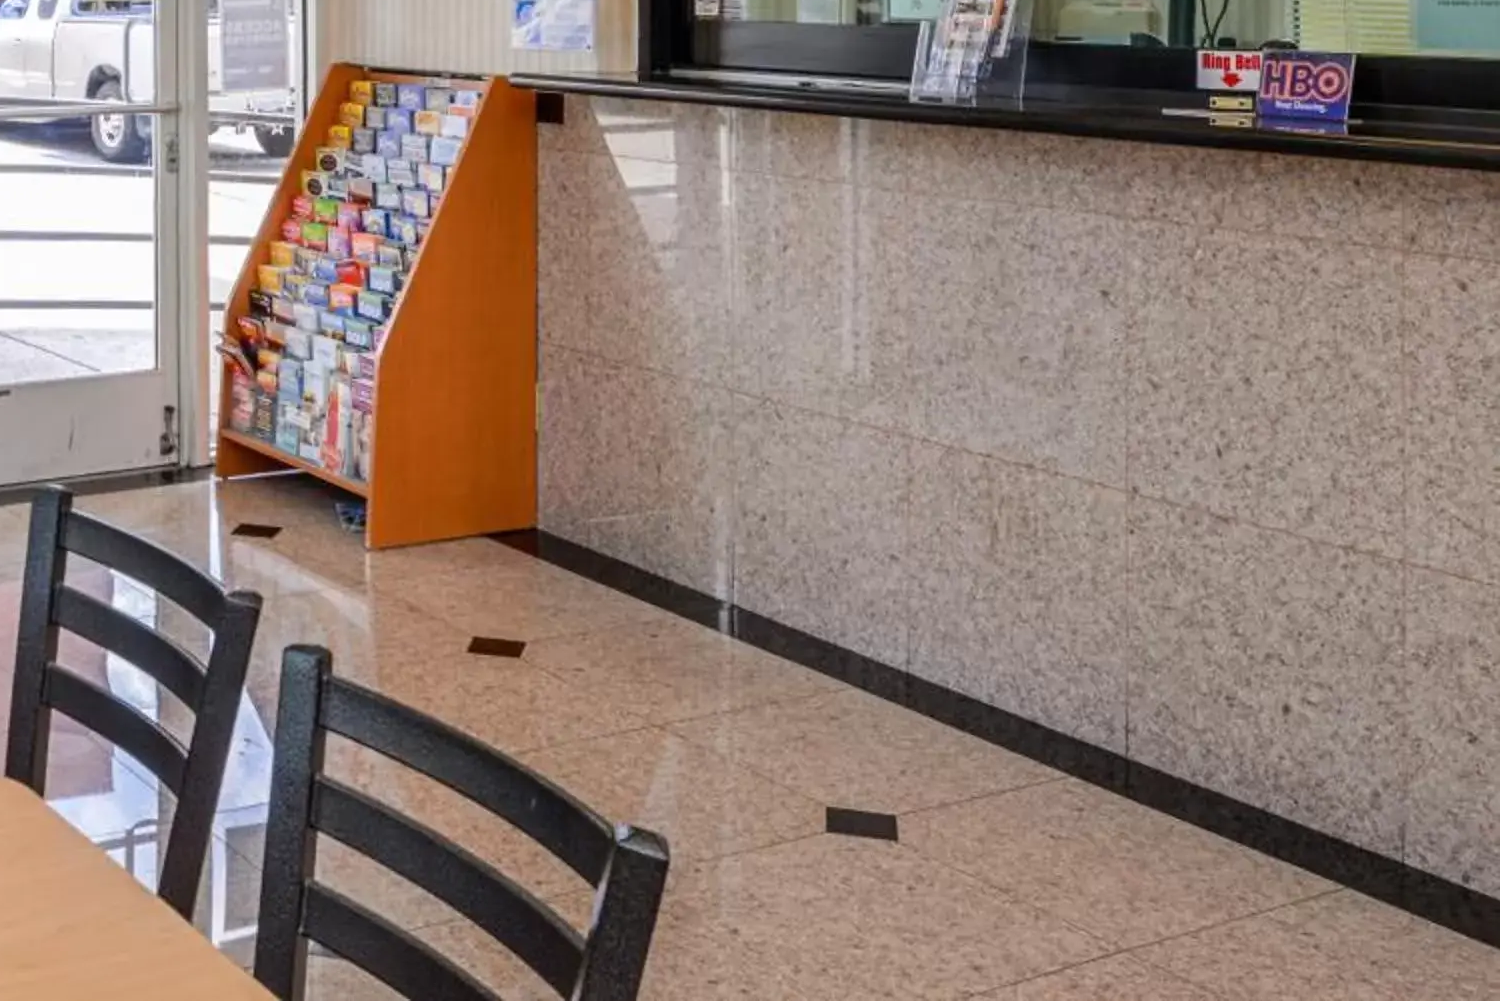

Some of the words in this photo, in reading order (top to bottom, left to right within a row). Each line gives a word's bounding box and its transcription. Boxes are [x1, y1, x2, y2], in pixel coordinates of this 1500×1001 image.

[1202, 53, 1231, 72] Ring
[1236, 53, 1261, 70] Bell
[1260, 60, 1349, 102] HBO
